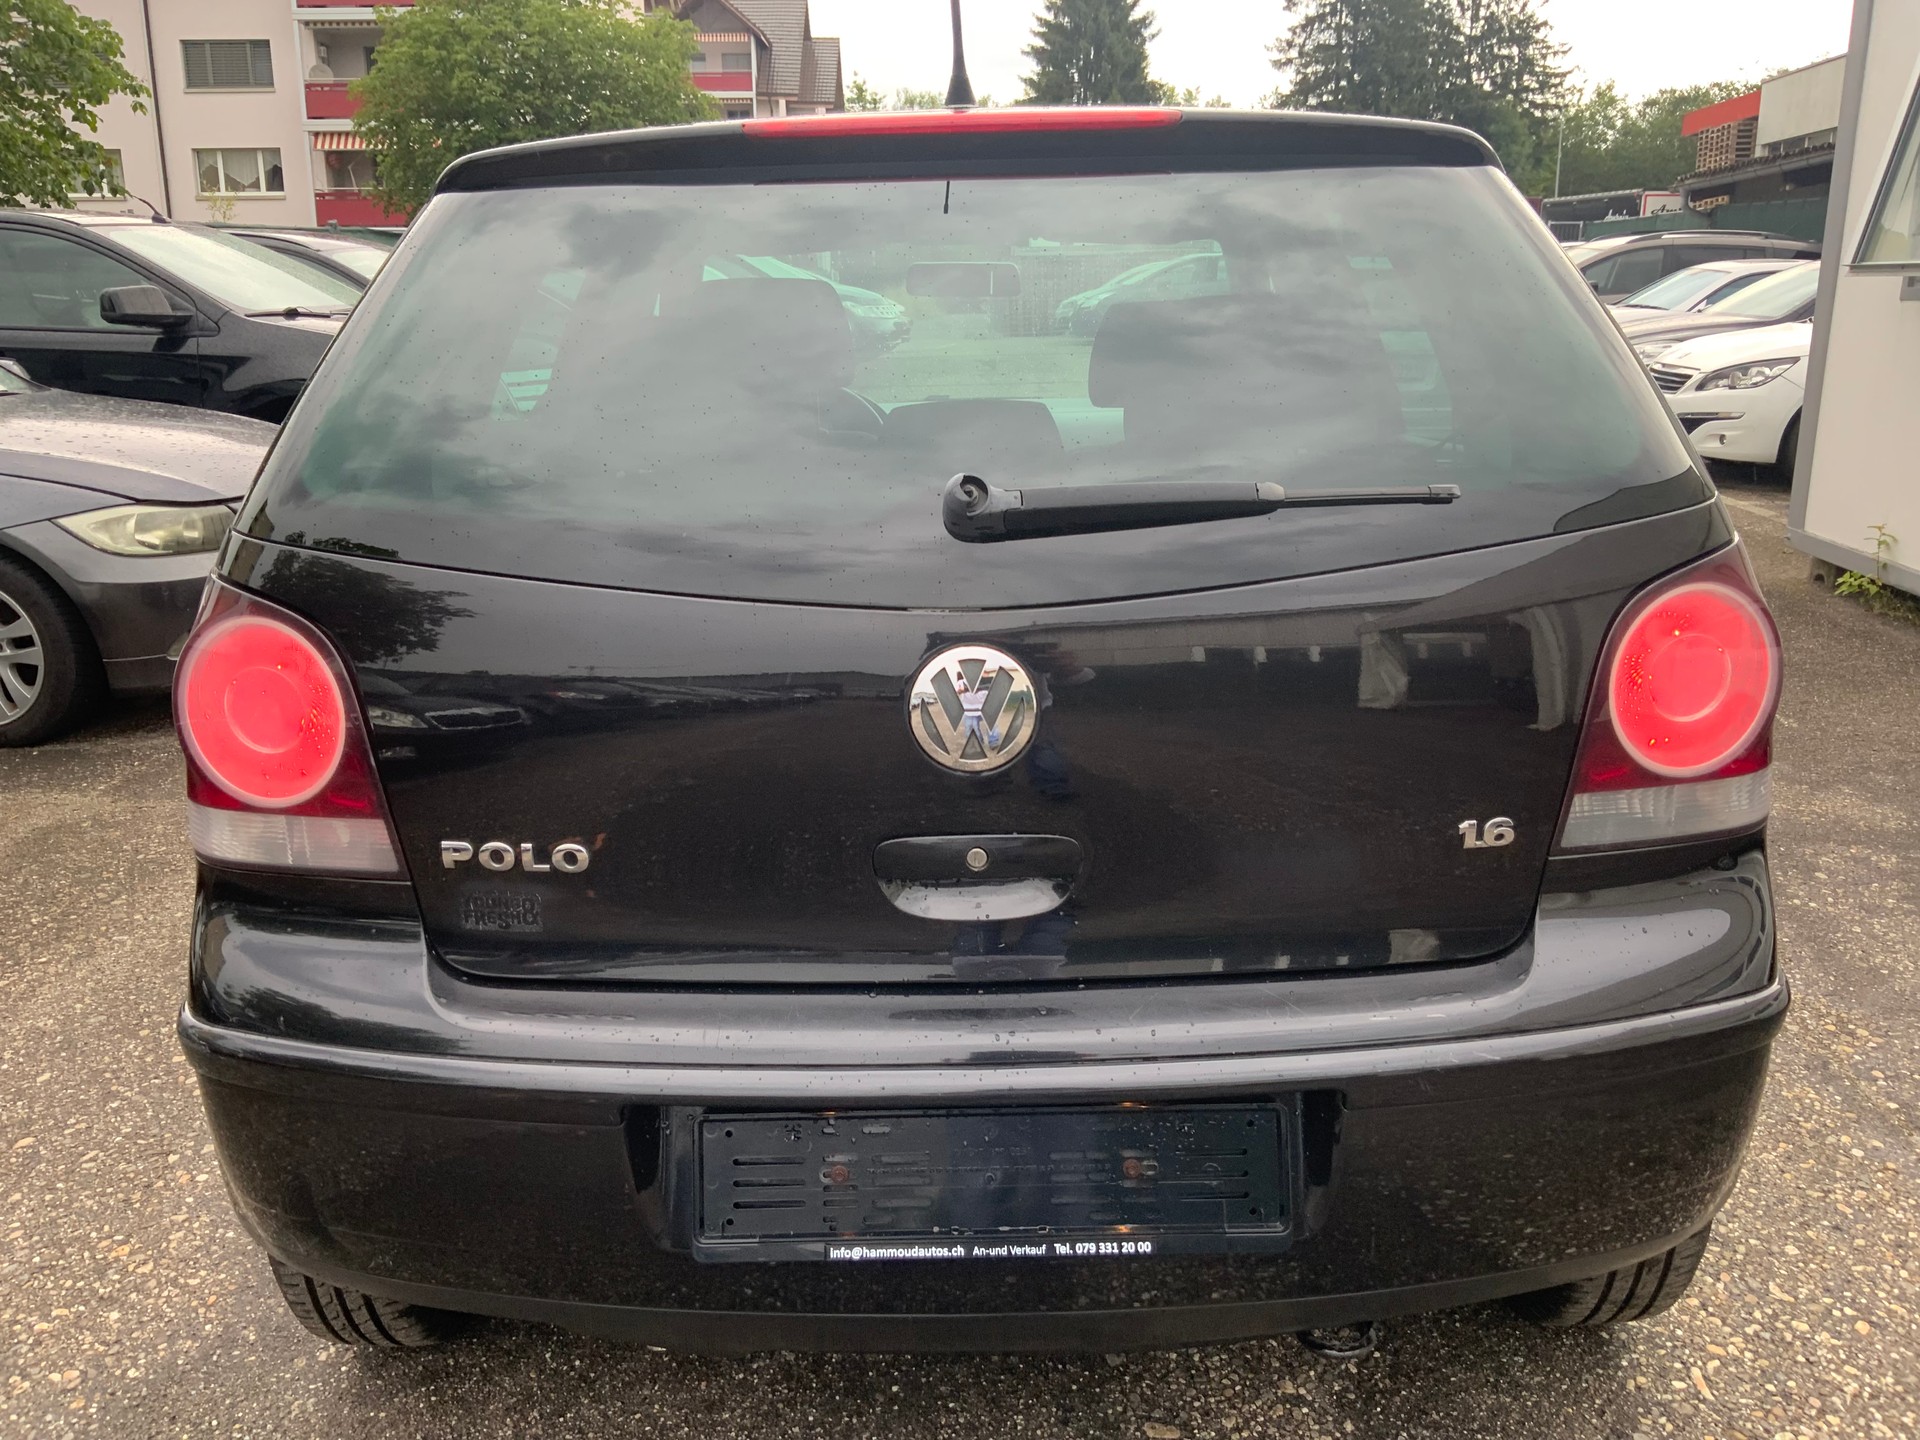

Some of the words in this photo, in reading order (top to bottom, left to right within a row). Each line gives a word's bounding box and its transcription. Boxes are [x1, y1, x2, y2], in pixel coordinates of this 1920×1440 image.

[440, 840, 590, 874] POLO
[1009, 1243, 1047, 1256] Verkauf
[1053, 1242, 1074, 1255] Tel.
[1075, 1242, 1097, 1254] 079
[1098, 1242, 1119, 1254] 331
[1121, 1241, 1135, 1253] 20
[1137, 1241, 1152, 1253] 00
